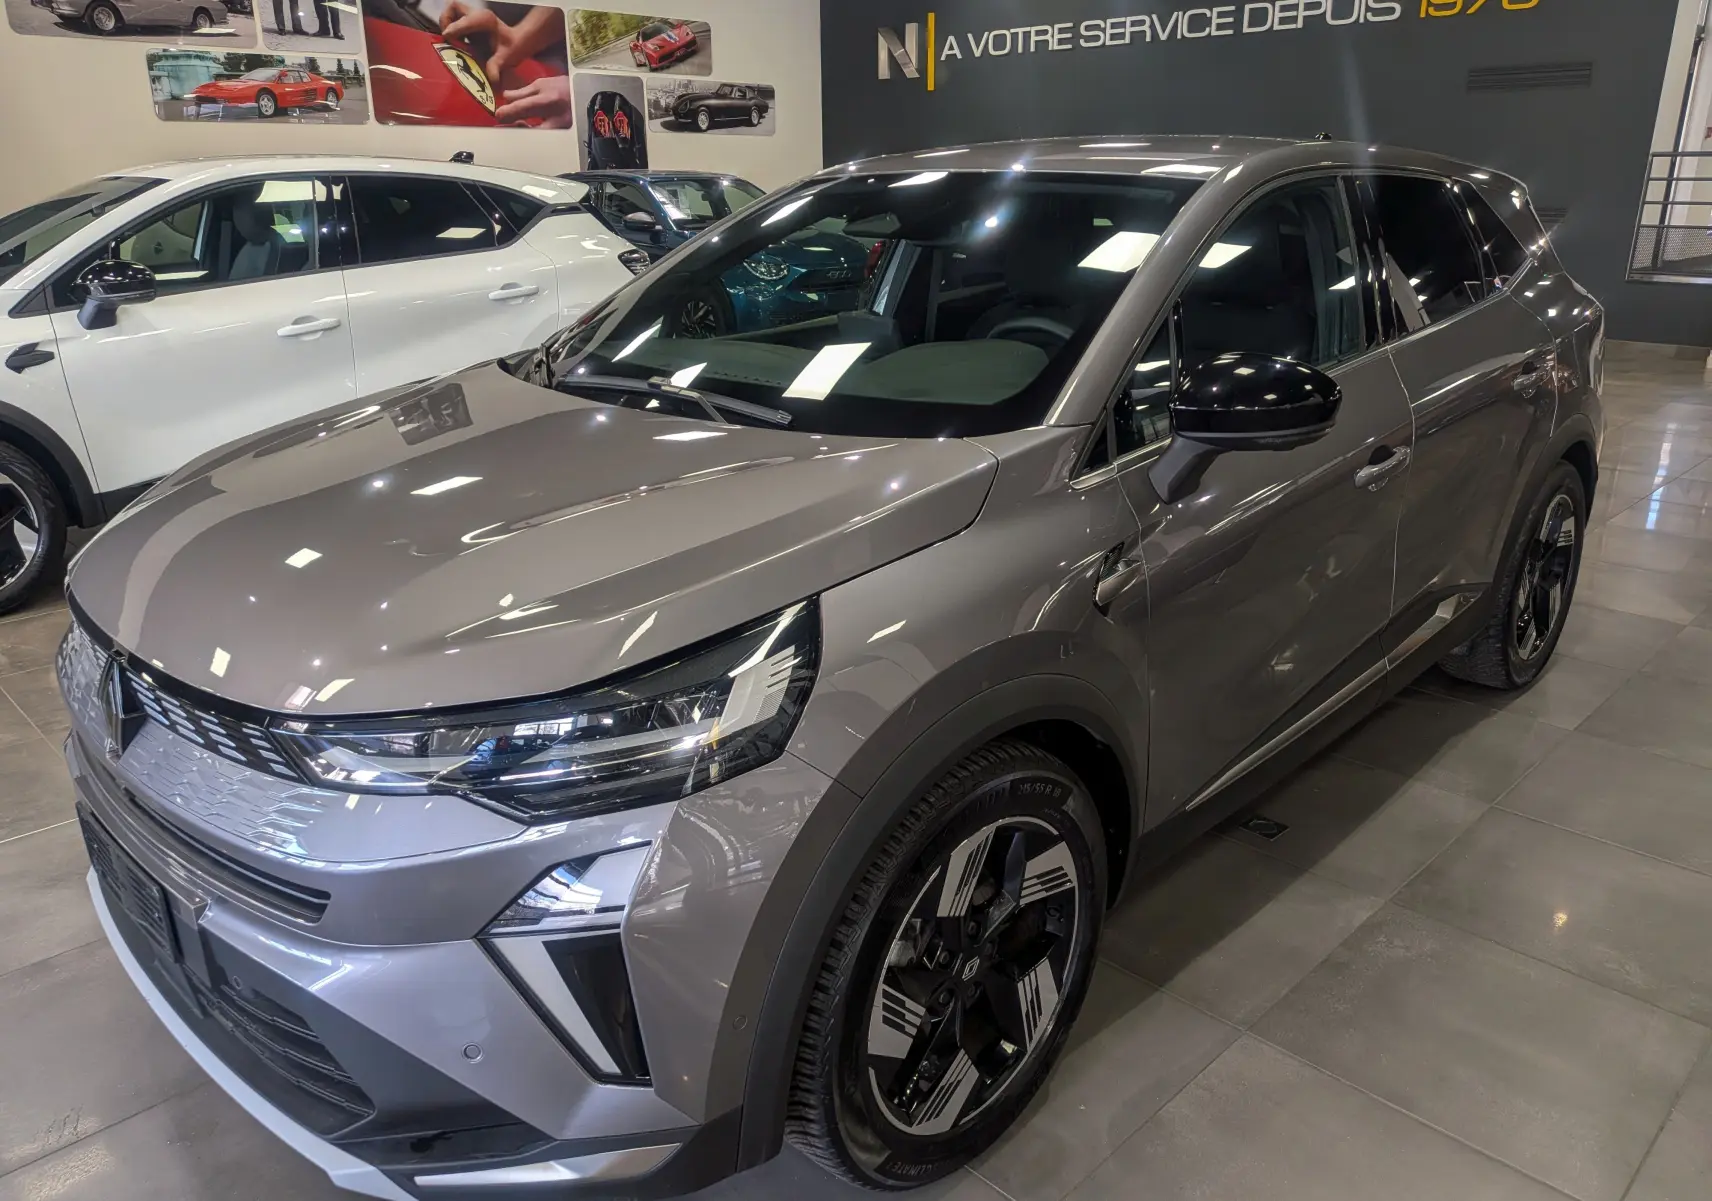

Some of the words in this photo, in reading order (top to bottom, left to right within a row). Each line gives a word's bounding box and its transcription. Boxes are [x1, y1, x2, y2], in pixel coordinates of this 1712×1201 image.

[878, 22, 920, 80] N
[940, 35, 963, 61] A
[967, 22, 1074, 58] VOTRE
[1079, 6, 1236, 48] SERVICE
[1242, 0, 1402, 33] DEPUIS
